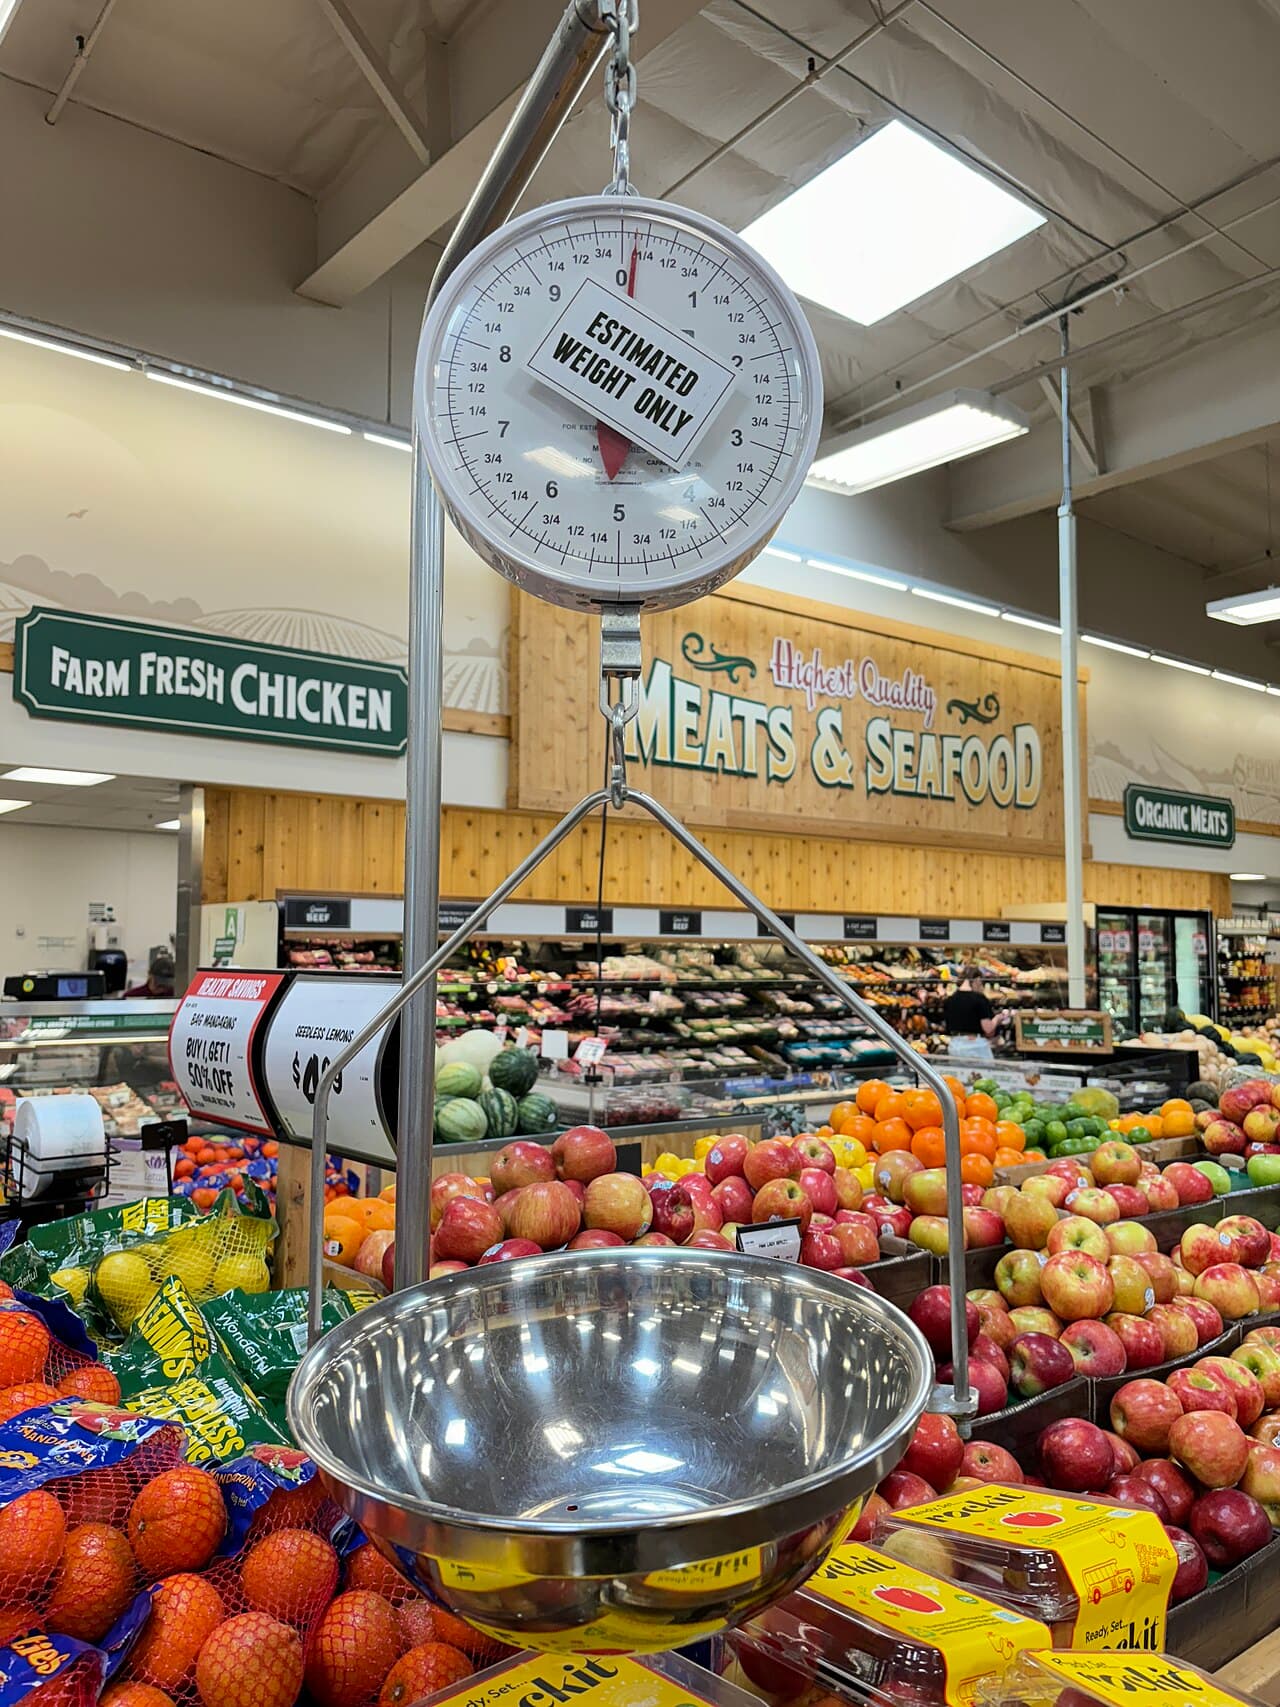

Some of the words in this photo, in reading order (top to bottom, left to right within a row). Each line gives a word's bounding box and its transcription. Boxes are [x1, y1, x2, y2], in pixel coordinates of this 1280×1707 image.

[594, 248, 612, 258] 3/4
[637, 251, 653, 260] 1/4
[573, 254, 589, 264] 1/2
[660, 258, 676, 268] 1/2
[548, 262, 565, 271] 1/4
[615, 269, 628, 286] 0
[680, 268, 698, 278] 3/4
[513, 286, 531, 296] 3/4
[549, 284, 561, 302] 9
[688, 291, 697, 308] 1
[713, 295, 730, 305] 1/4
[497, 303, 514, 313] 1/2
[728, 313, 744, 322] 1/2
[484, 323, 502, 333] 1/4
[738, 334, 756, 344] 3/4
[499, 345, 511, 363] 8
[585, 311, 699, 397] ESTIMATED
[470, 362, 488, 372] 3/4
[753, 374, 770, 384] 1/4
[468, 384, 486, 393] 1/2
[552, 332, 637, 400] WEIGHT
[633, 388, 694, 437] ONLY
[755, 394, 772, 404] 1/2
[468, 406, 487, 416] 1/4
[751, 417, 768, 426] 3/4
[498, 420, 510, 438] 7
[731, 429, 743, 446] 3
[484, 454, 502, 464] 3/4
[737, 463, 754, 473] 1/4
[495, 473, 513, 483] 1/2
[546, 480, 558, 498] 6
[726, 481, 743, 491] 1/2
[511, 490, 528, 500] 1/4
[683, 485, 696, 502] 4
[708, 497, 726, 508] 3/4
[613, 504, 625, 522] 5
[543, 514, 560, 525] 3/4
[680, 520, 697, 530] 1/4
[567, 526, 584, 536] 1/2
[659, 529, 676, 539] 1/2
[590, 533, 608, 543] 1/4
[633, 534, 650, 544] 3/4
[770, 637, 856, 711] Highest
[859, 656, 936, 729] Quality
[50, 645, 130, 697] FARM
[139, 651, 225, 705] FRESH
[230, 662, 393, 733] CHICKEN
[620, 657, 797, 784] MEATS
[811, 705, 854, 790] &
[865, 715, 1043, 812] SEAFOOD
[1135, 796, 1189, 832] ORGANIC
[1190, 804, 1228, 837] MEATS
[306, 912, 330, 922] BEEF
[197, 977, 233, 996] HEALTHY
[228, 978, 266, 999] SAVINGS
[190, 1012, 203, 1026] BAG
[204, 1014, 237, 1030] MANDARINS
[295, 1026, 325, 1040] SEEDLESS
[326, 1028, 354, 1043] LEMONS
[186, 1038, 202, 1060] BUY
[209, 1041, 226, 1062] GET
[188, 1062, 213, 1091] 50%
[212, 1068, 233, 1096] OFF
[13, 1266, 38, 1290] nderful
[138, 1295, 195, 1378] LEMONS
[216, 1311, 275, 1376] Wonderful
[166, 1378, 246, 1458] SEEDLESS
[926, 1492, 1026, 1523] rockit
[1085, 1624, 1110, 1644] Ready,
